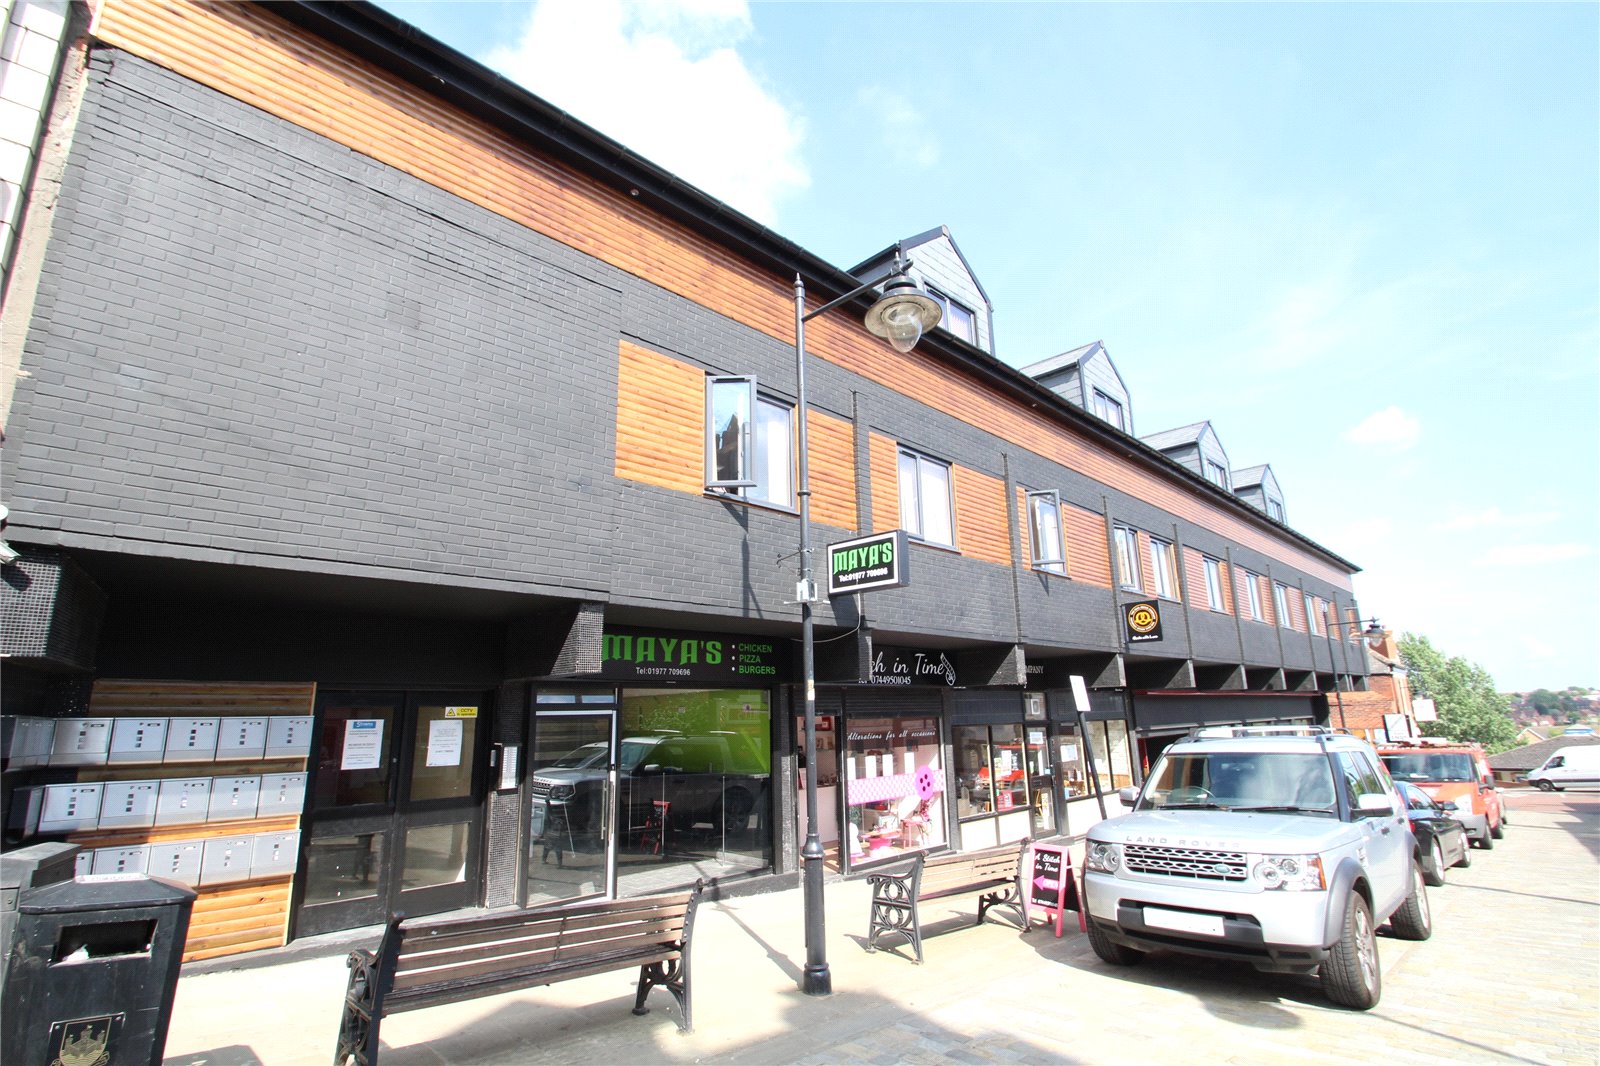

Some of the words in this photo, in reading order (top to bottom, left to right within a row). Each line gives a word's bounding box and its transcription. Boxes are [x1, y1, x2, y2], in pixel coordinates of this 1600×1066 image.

[833, 542, 893, 575] MAYA'S
[602, 634, 722, 666] MAYA'S
[738, 643, 773, 653] CHICKEN
[739, 654, 761, 663] PIZZA
[893, 657, 909, 673] in
[914, 653, 945, 675] Time
[635, 666, 667, 675] Tel:01977
[668, 667, 691, 676] 709696
[738, 666, 776, 675] BURGERS
[847, 732, 882, 741] Alterations
[885, 730, 895, 741] for
[898, 729, 908, 738] all
[1126, 835, 1168, 844] LAND
[1179, 839, 1240, 849] ROVER
